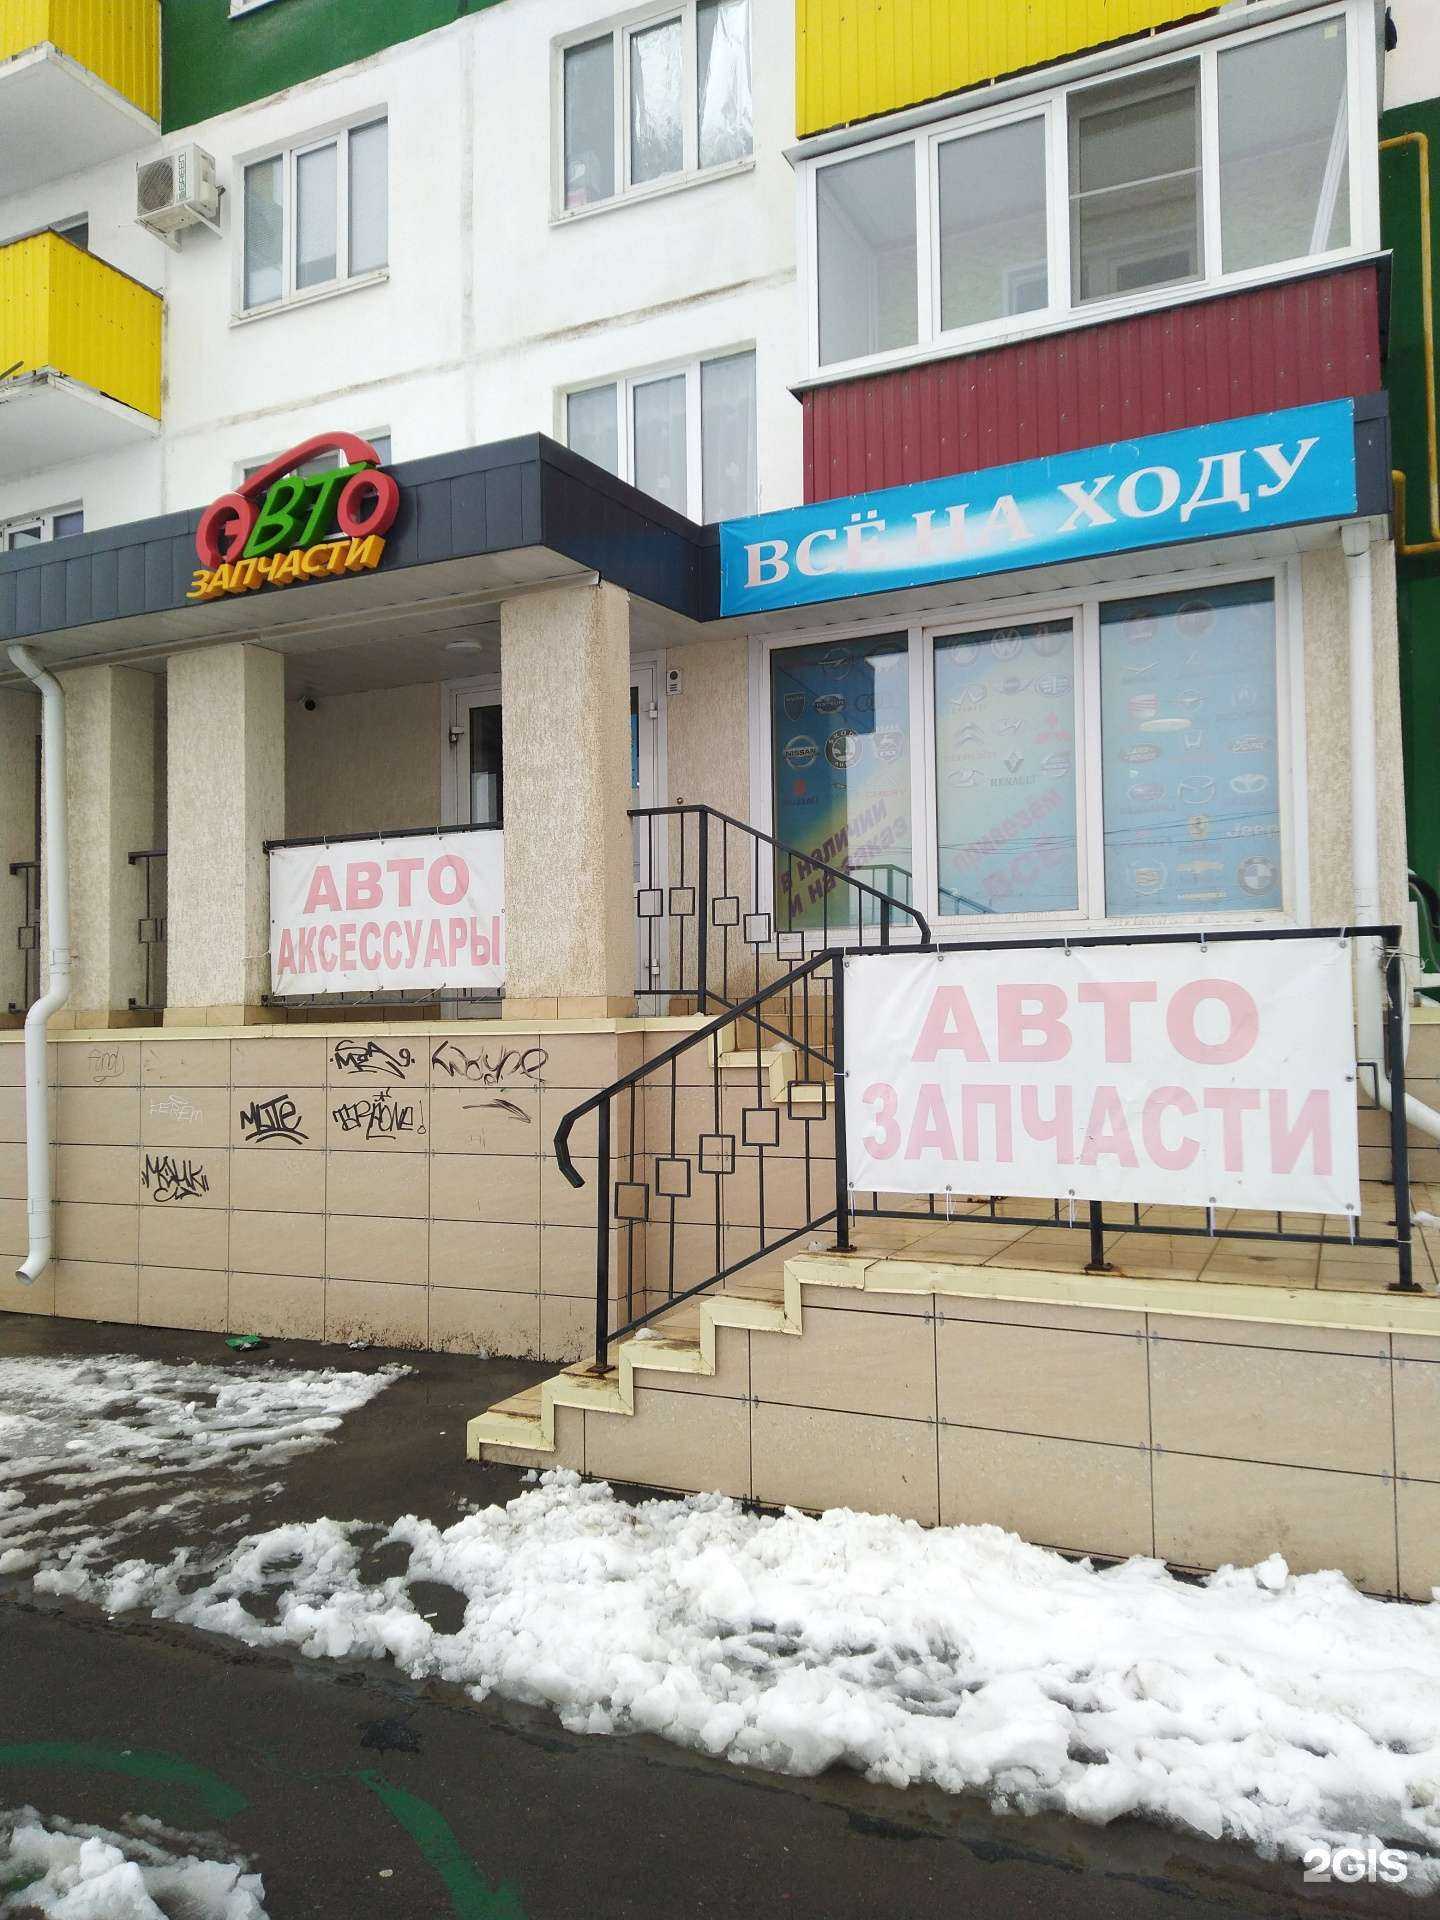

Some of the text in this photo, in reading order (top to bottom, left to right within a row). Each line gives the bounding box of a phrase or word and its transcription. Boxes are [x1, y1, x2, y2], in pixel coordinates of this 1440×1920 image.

[743, 436, 1321, 589] ВСЁ НА ХОДУ
[186, 534, 386, 601] ЗАПЧАСТИ
[302, 853, 470, 915] АВТО
[276, 914, 501, 976] АКСЕССУАРЫ
[911, 978, 1260, 1066] АВТО
[862, 1081, 1334, 1177] ЗАПЧАСТИ
